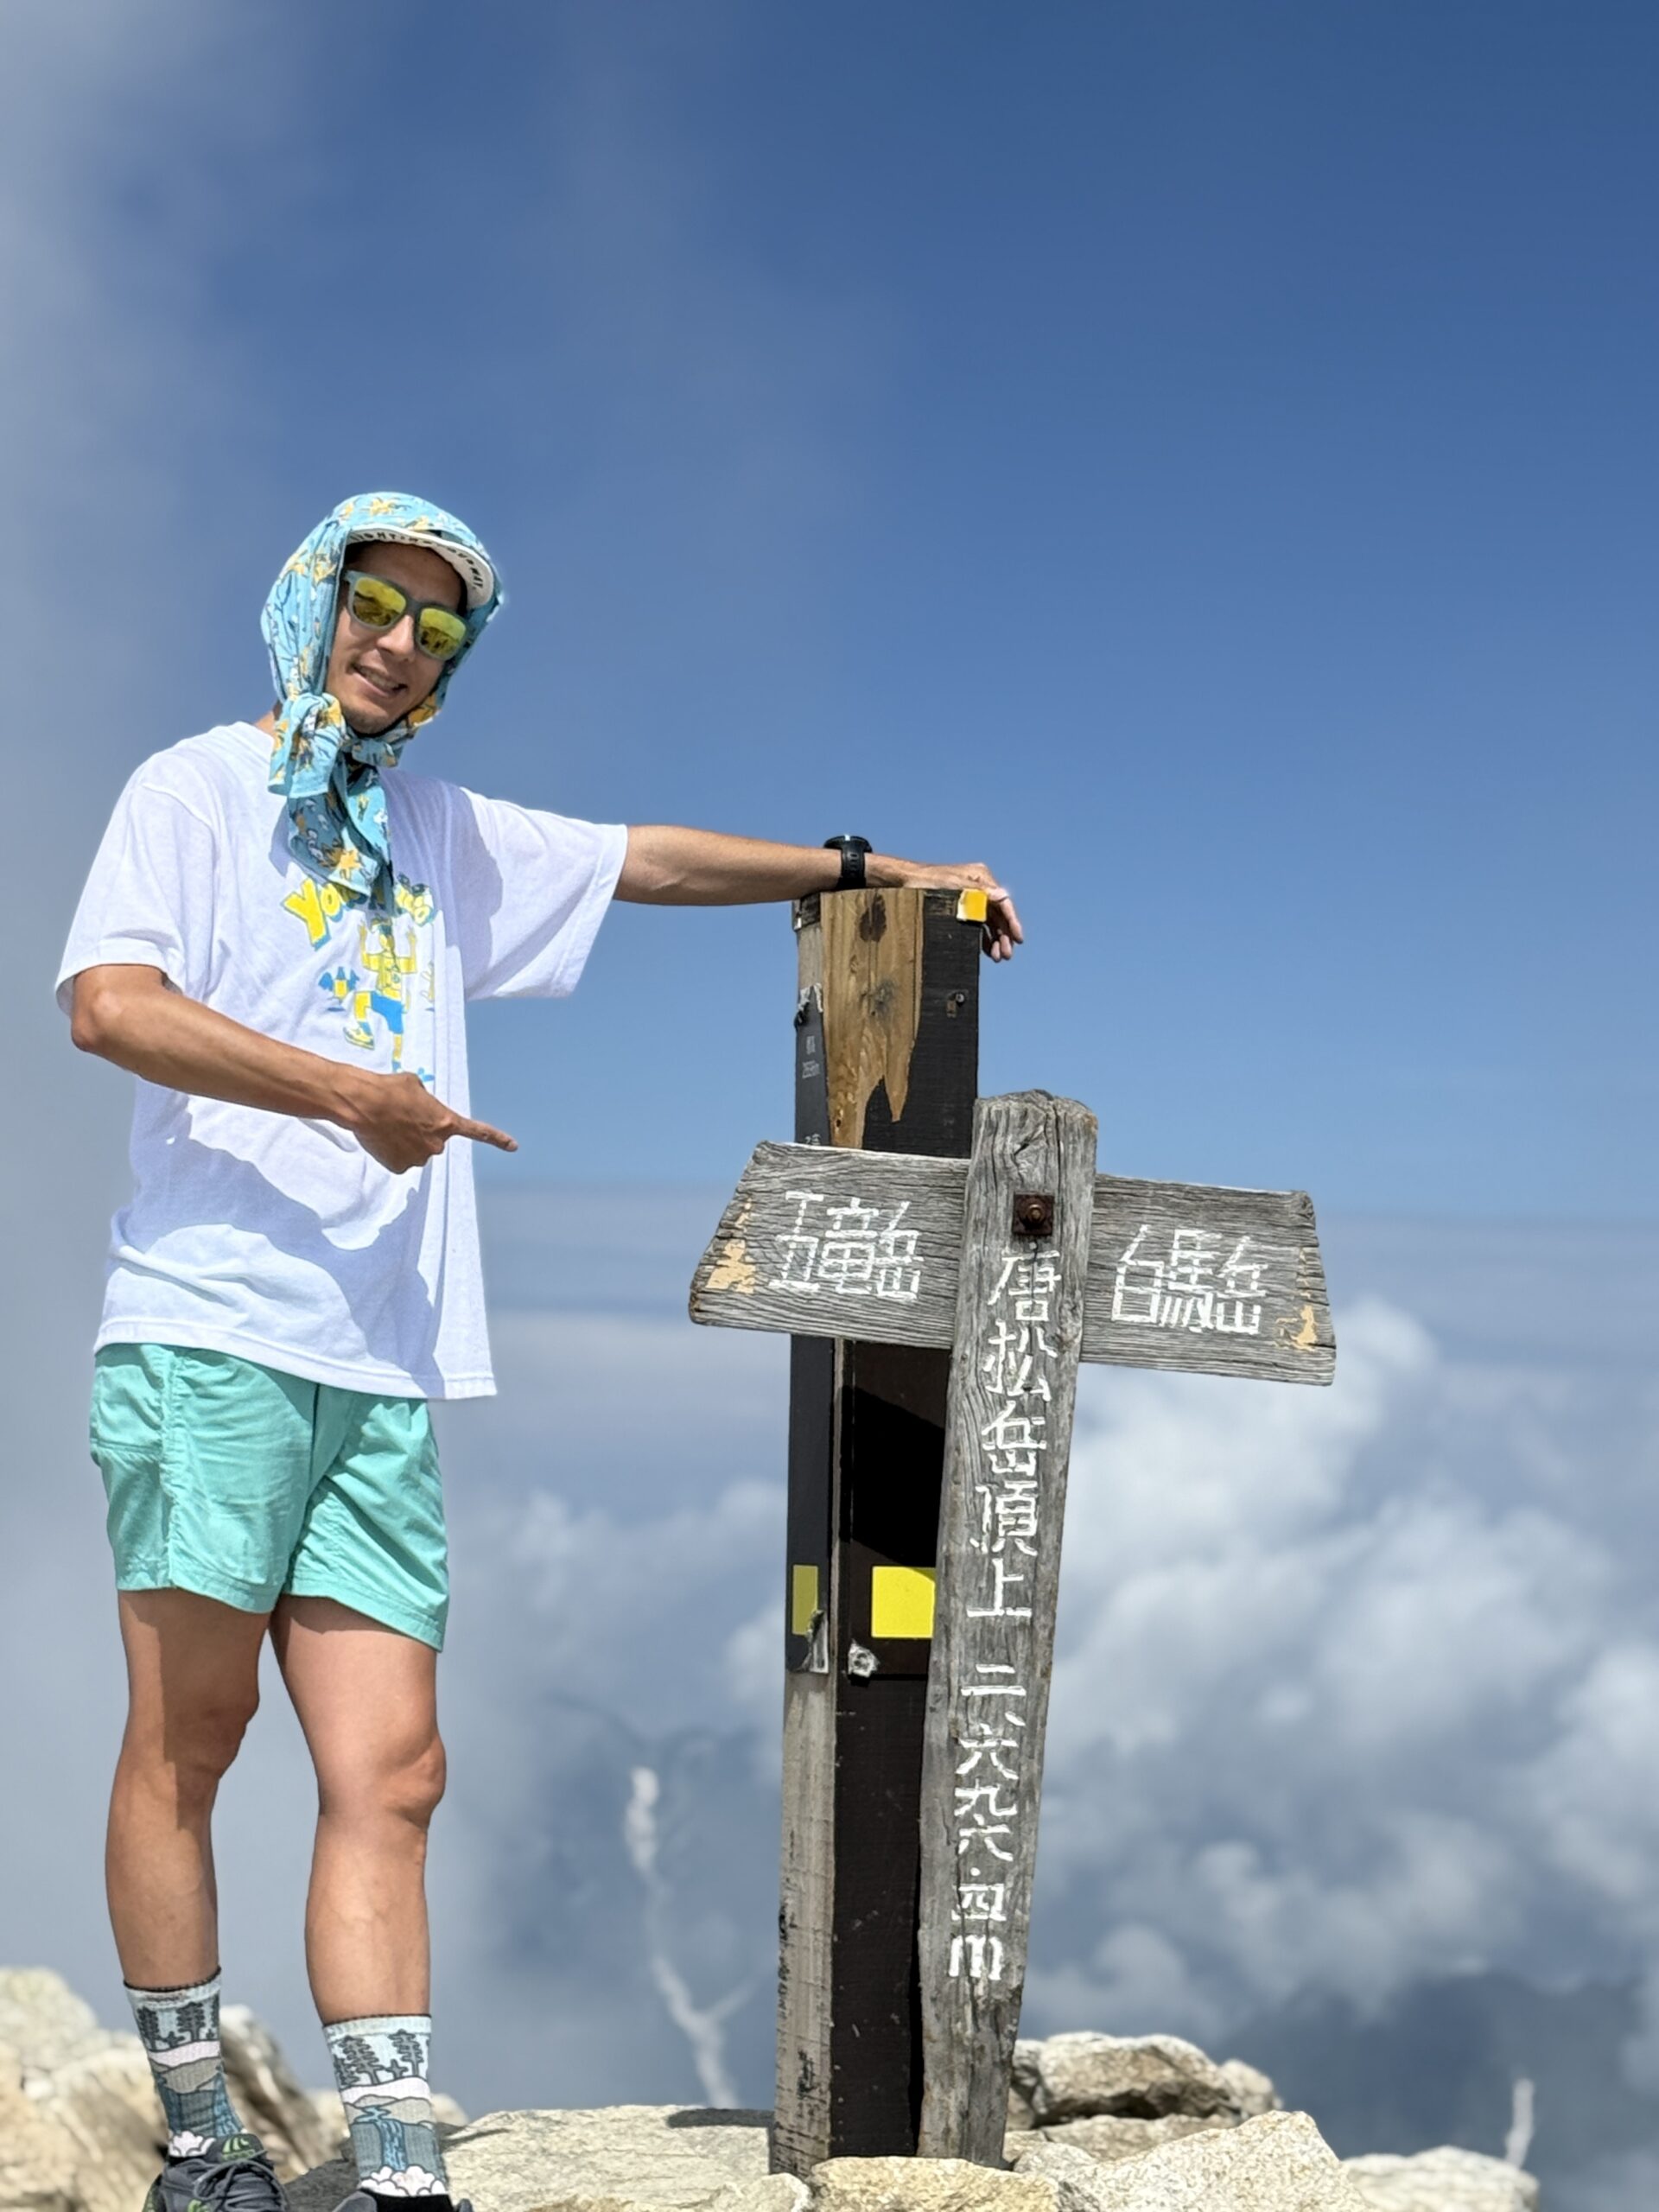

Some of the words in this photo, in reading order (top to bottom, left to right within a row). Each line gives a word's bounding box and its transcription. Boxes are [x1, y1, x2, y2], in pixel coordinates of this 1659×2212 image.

[768, 1191, 925, 1300] 五竜岳
[1111, 1224, 1269, 1335] 白馬岳
[967, 1251, 1061, 1618] 唐松岳頂上
